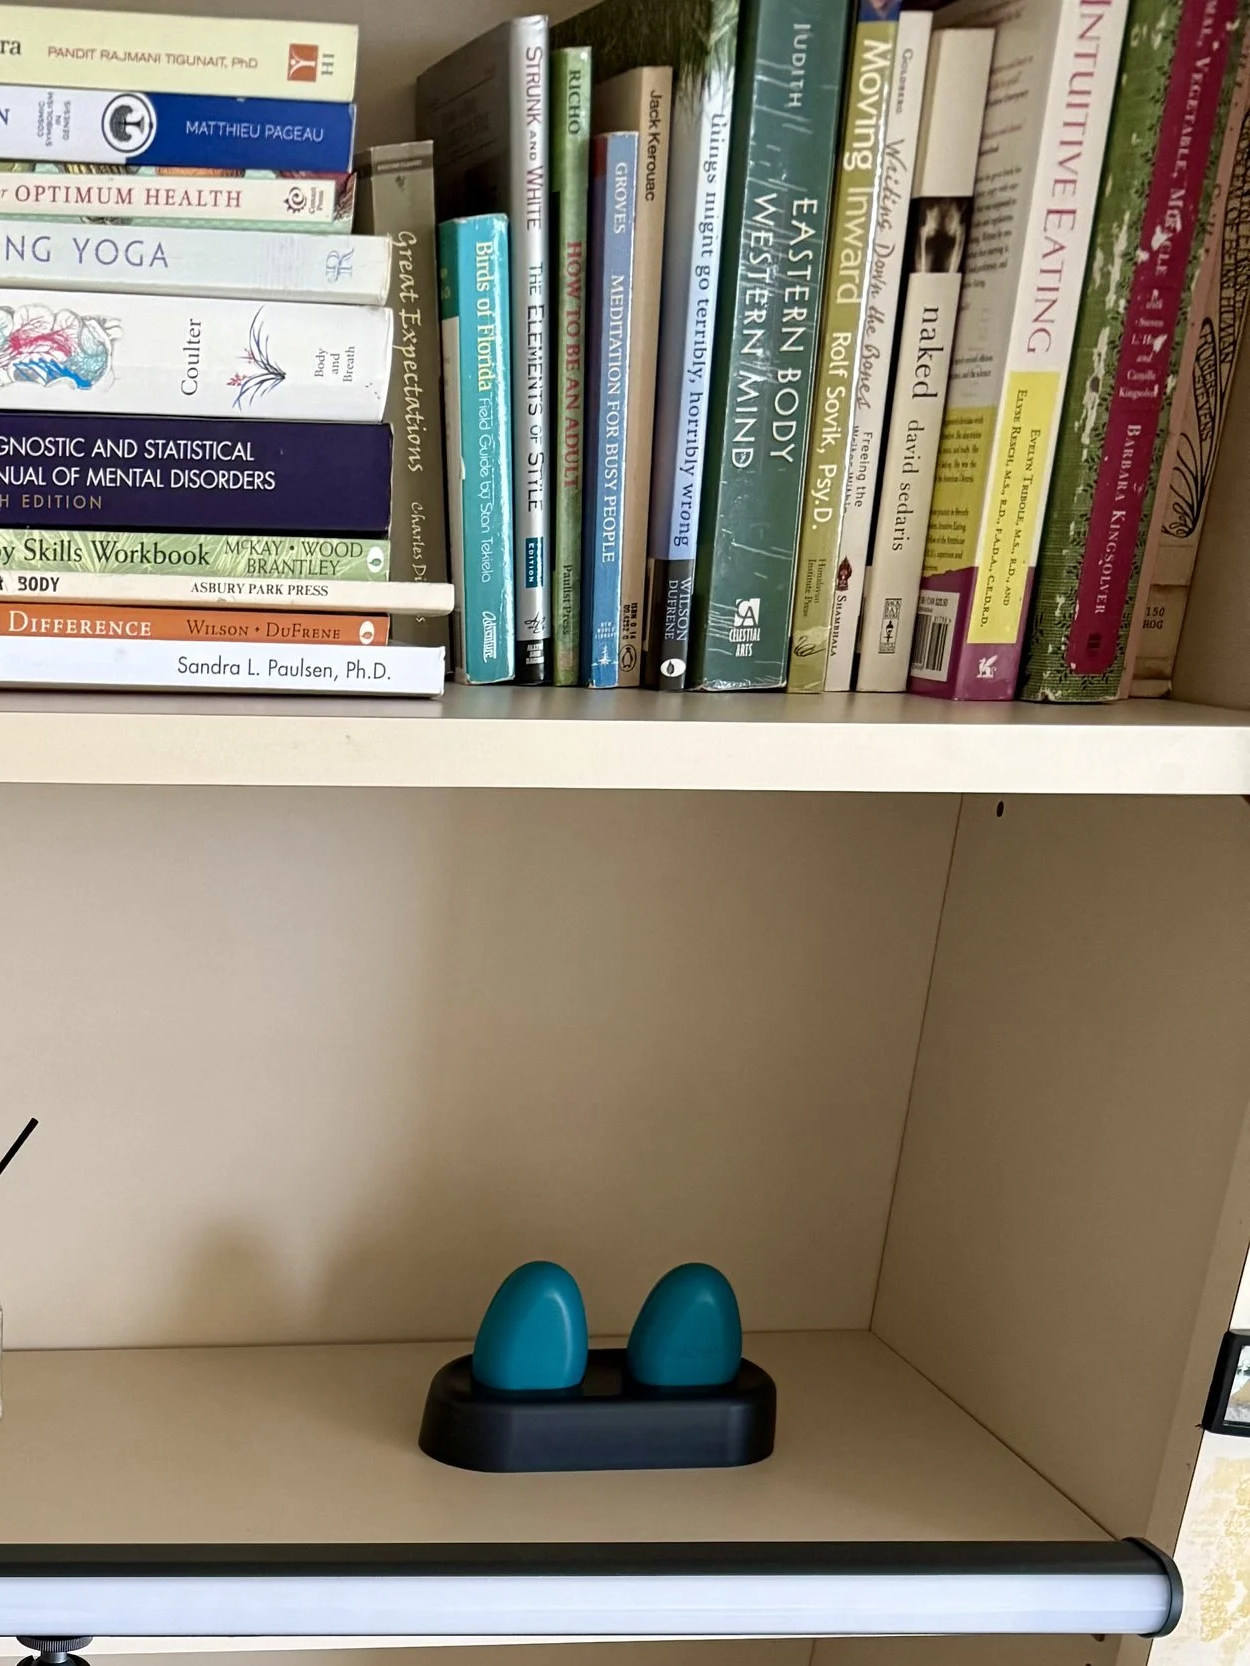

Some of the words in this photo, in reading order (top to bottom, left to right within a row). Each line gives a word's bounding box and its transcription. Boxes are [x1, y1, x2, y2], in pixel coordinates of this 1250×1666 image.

[48, 46, 98, 61] PANDIT
[100, 49, 162, 65] RAJMANI
[165, 53, 228, 70] TIGUNAIT,
[232, 56, 259, 70] PhD
[567, 69, 581, 136] RICHO
[649, 88, 662, 129] Jack
[844, 40, 893, 171] Moving
[1051, 0, 1112, 198] INTUITIVE
[185, 121, 261, 140] MATTHIEU
[265, 125, 325, 143] PAGEAU
[645, 131, 661, 202] Kerouac
[13, 184, 136, 207] OPTIMUM
[144, 188, 243, 210] HEALTH
[613, 161, 628, 236] GROVES
[72, 236, 169, 270] YOGA
[397, 230, 419, 301] Great
[835, 186, 875, 306] Inward
[566, 241, 583, 305] HOW
[741, 193, 779, 356] WESTERN
[779, 197, 818, 353] EASTERN
[1026, 207, 1078, 355] EATING
[566, 309, 582, 339] TO
[606, 275, 624, 394] MEDITATION
[180, 318, 203, 397] Coulter
[314, 347, 328, 379] Body
[329, 352, 341, 375] and
[342, 345, 356, 383] Breath
[565, 341, 581, 369] BE
[828, 331, 853, 379] Rolf
[912, 306, 945, 400] naked
[392, 307, 426, 473] Expectations
[564, 376, 581, 411] AN
[605, 400, 622, 439] FOR
[731, 368, 760, 469] MIND
[770, 367, 801, 464] BODY
[816, 392, 846, 454] Sovik,
[91, 437, 138, 460] AND
[144, 439, 256, 462] STATISTICAL
[563, 419, 581, 489] ADULT
[604, 441, 619, 491] BUSY
[856, 430, 873, 477] Freeing
[902, 419, 925, 475] david
[21, 494, 104, 511] EDITION
[51, 466, 81, 487] OF
[86, 467, 166, 489] MENTAL
[170, 468, 276, 492] DISORDERS
[811, 463, 838, 531] Psy.D.
[854, 484, 867, 509] the
[602, 494, 617, 564] PEOPLE
[892, 481, 914, 552] sedaris
[23, 539, 83, 565] Skills
[90, 539, 211, 567] Workbook
[246, 558, 341, 577] BRANTLEY
[190, 581, 247, 597] ASBURY
[248, 582, 284, 597] PARK
[285, 583, 330, 598] PRESS
[676, 577, 692, 641] WILSON
[1145, 606, 1166, 619] 150
[729, 627, 761, 643] CELESTIAL
[735, 642, 753, 657] ARTS
[177, 655, 241, 677] Sandra
[248, 658, 261, 677] L.
[268, 658, 339, 682] Paulsen,
[346, 660, 392, 681] Ph.D.
